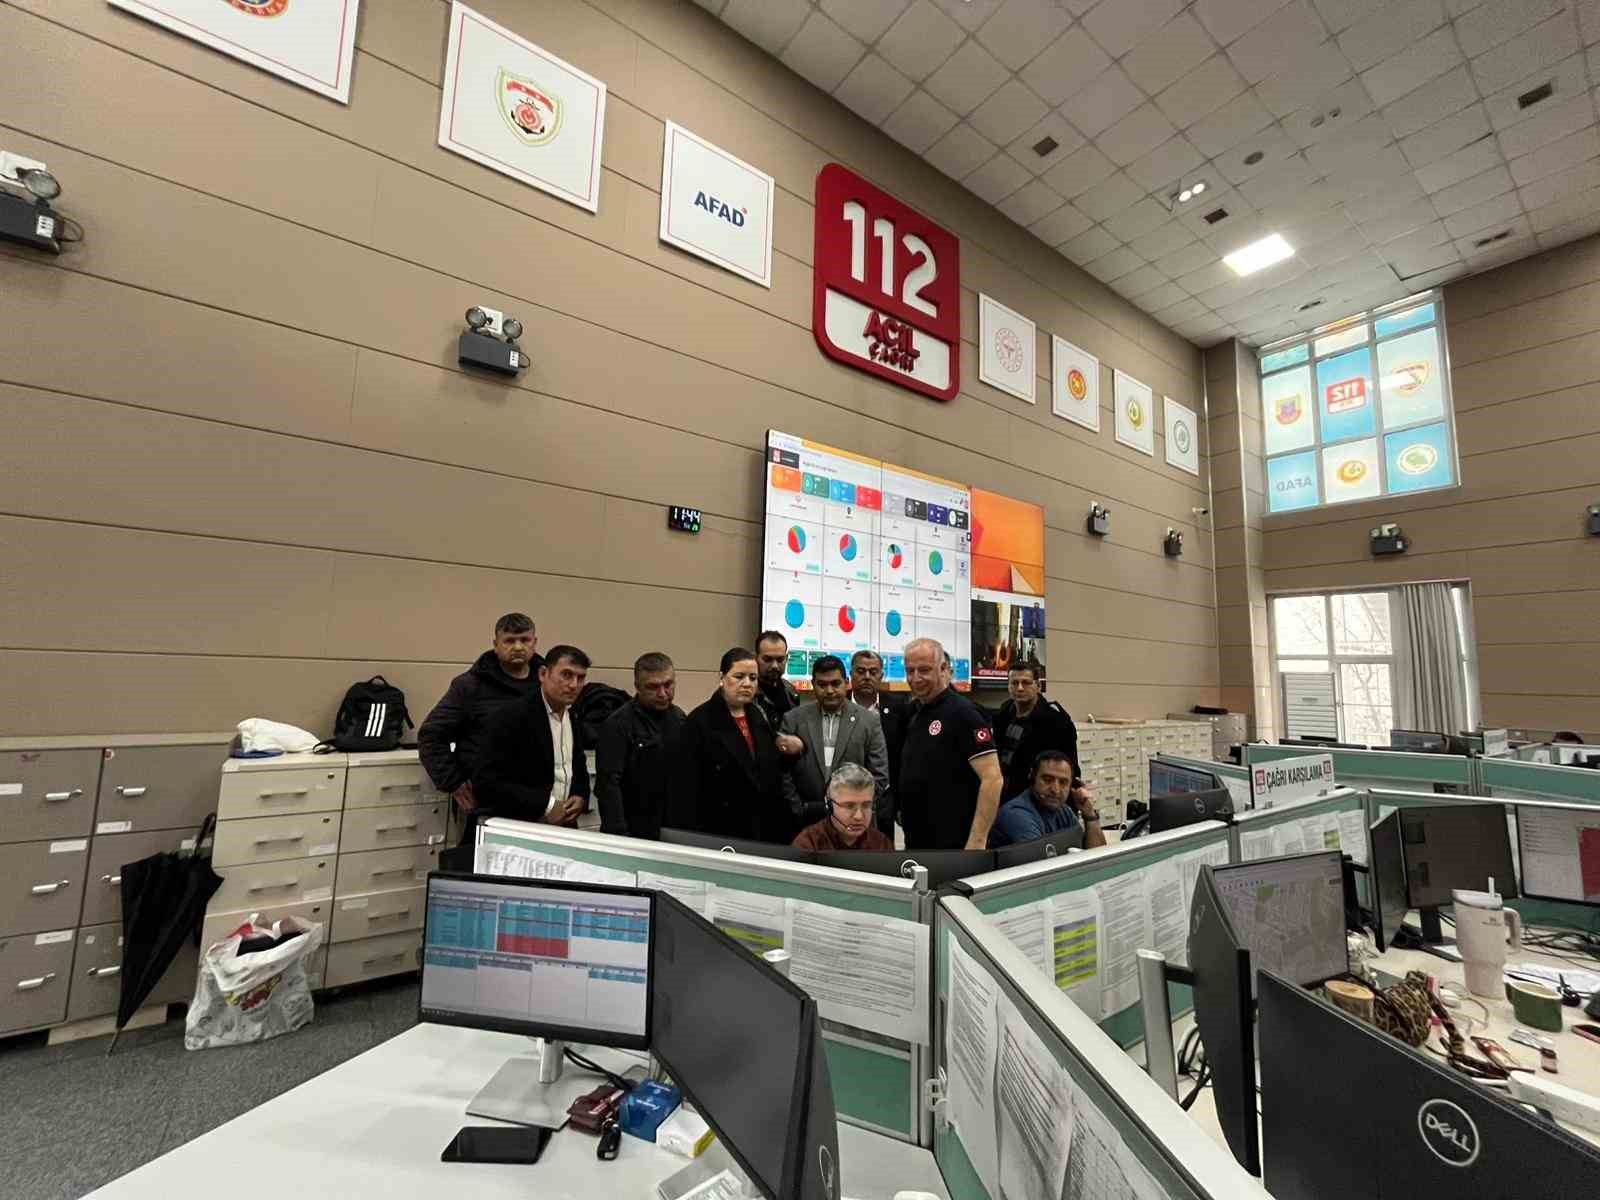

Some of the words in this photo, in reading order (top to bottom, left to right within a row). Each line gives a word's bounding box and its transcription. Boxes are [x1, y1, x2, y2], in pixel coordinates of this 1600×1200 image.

[693, 190, 745, 228] AFAD
[842, 200, 938, 319] 112
[1266, 767, 1287, 793] ÇAĞRI
[1287, 764, 1323, 787] KARŞILAMA
[1425, 1112, 1471, 1153] DELL
